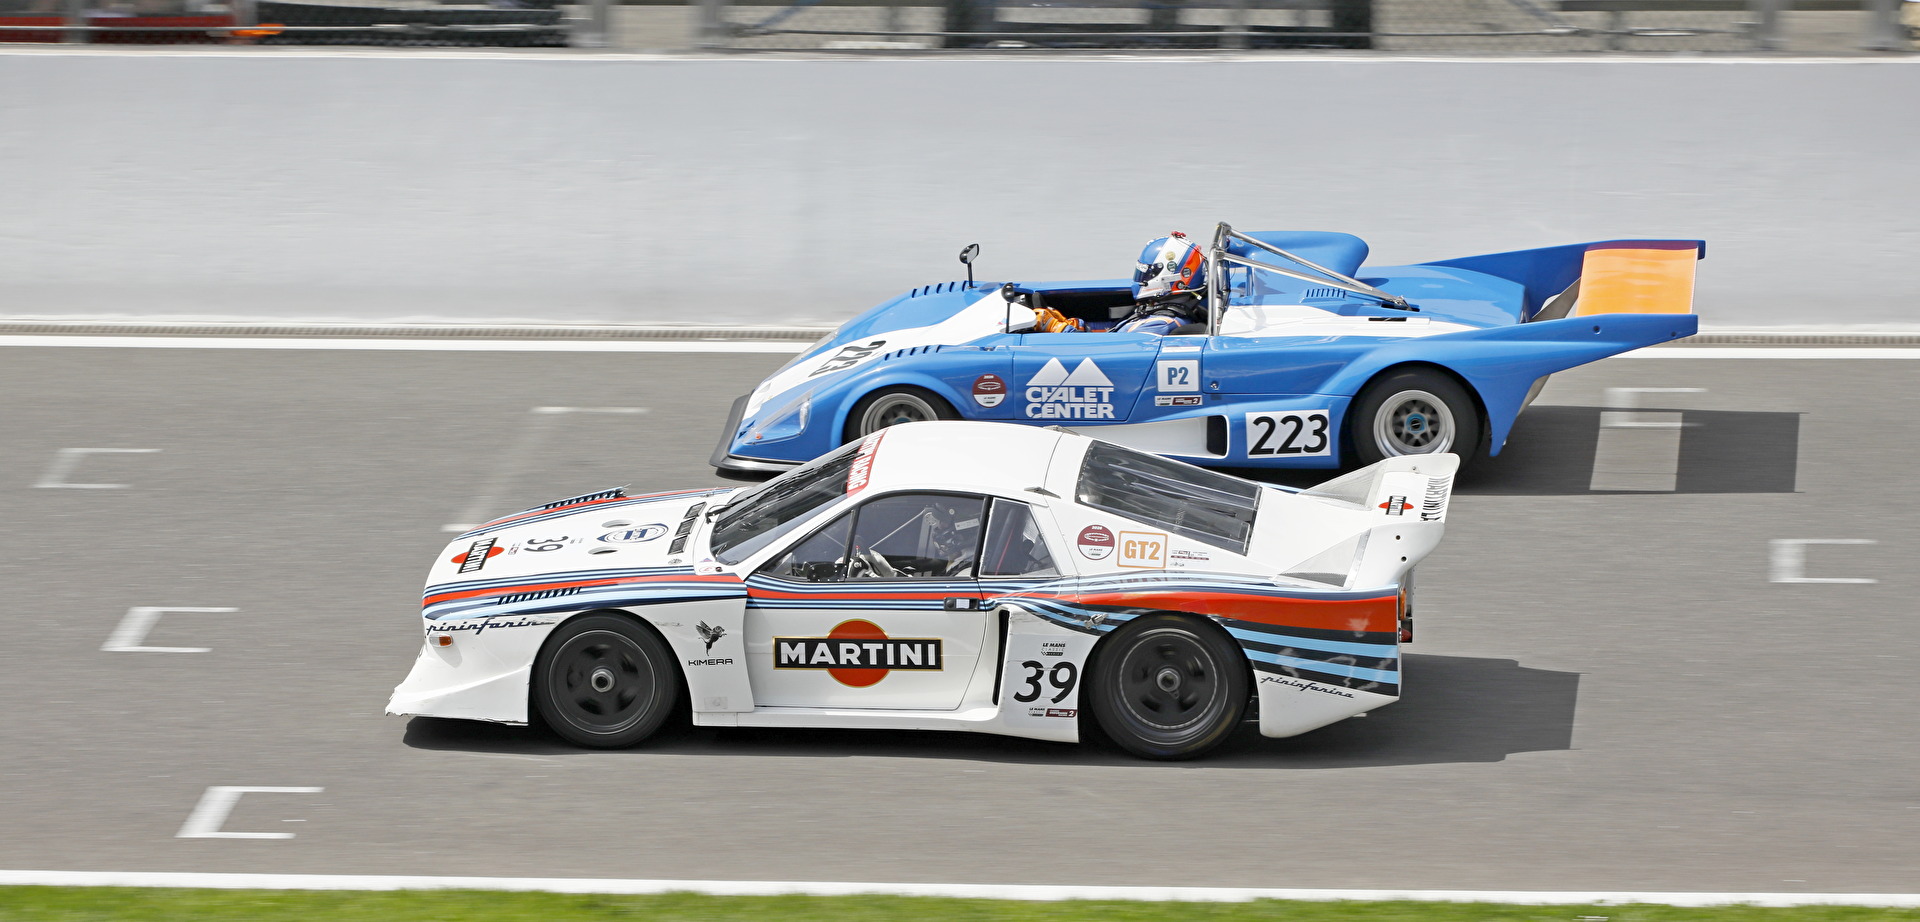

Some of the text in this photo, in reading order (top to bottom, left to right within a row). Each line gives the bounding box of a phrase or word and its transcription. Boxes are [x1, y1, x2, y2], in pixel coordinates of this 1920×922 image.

[808, 340, 887, 378] 223
[1167, 366, 1189, 385] P2
[1025, 386, 1115, 403] CHALET
[1025, 402, 1116, 419] CENTER
[1248, 413, 1329, 455] 223
[847, 455, 872, 490] RACING
[1423, 475, 1451, 511] MARTINI
[523, 535, 569, 552] 39
[1124, 539, 1161, 561] GT2
[459, 538, 496, 574] MARTINI
[688, 658, 734, 667] KIMERA
[780, 642, 936, 666] MARTINI
[1013, 660, 1077, 704] 39
[1261, 676, 1355, 699] pininfarina
